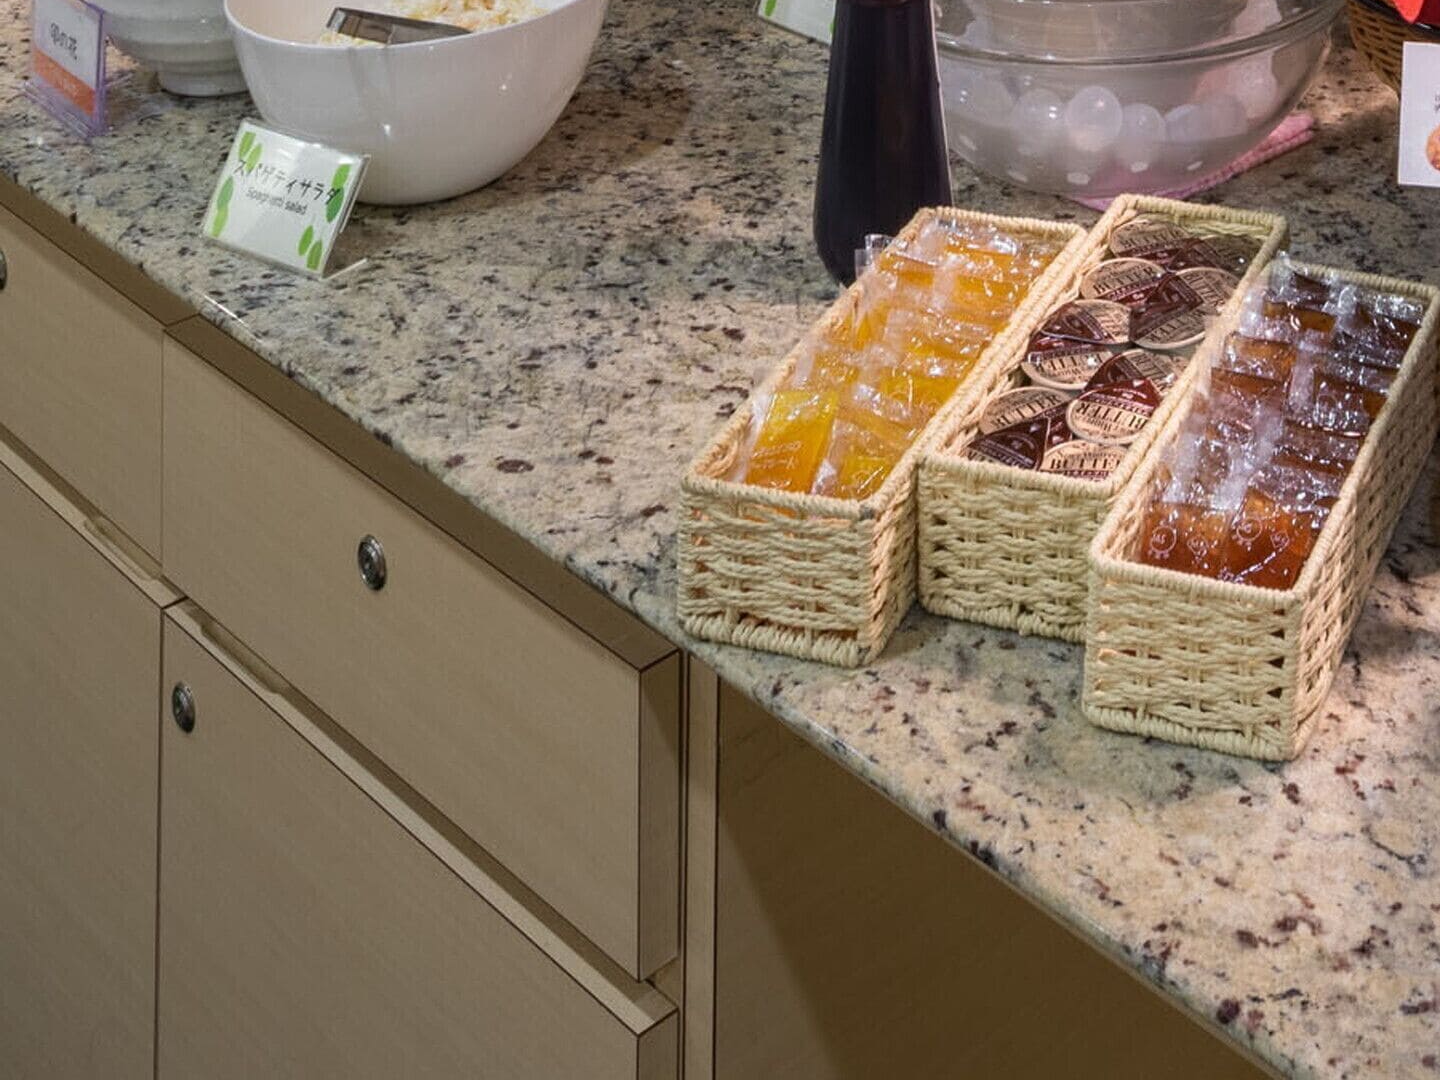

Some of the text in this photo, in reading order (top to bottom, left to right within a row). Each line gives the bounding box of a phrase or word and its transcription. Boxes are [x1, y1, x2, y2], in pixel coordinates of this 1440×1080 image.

[234, 159, 340, 205] スパゲティサラダ
[1091, 265, 1159, 296] BUTTER
[995, 392, 1063, 429] BUTTER
[1077, 401, 1148, 430] BUTTER
